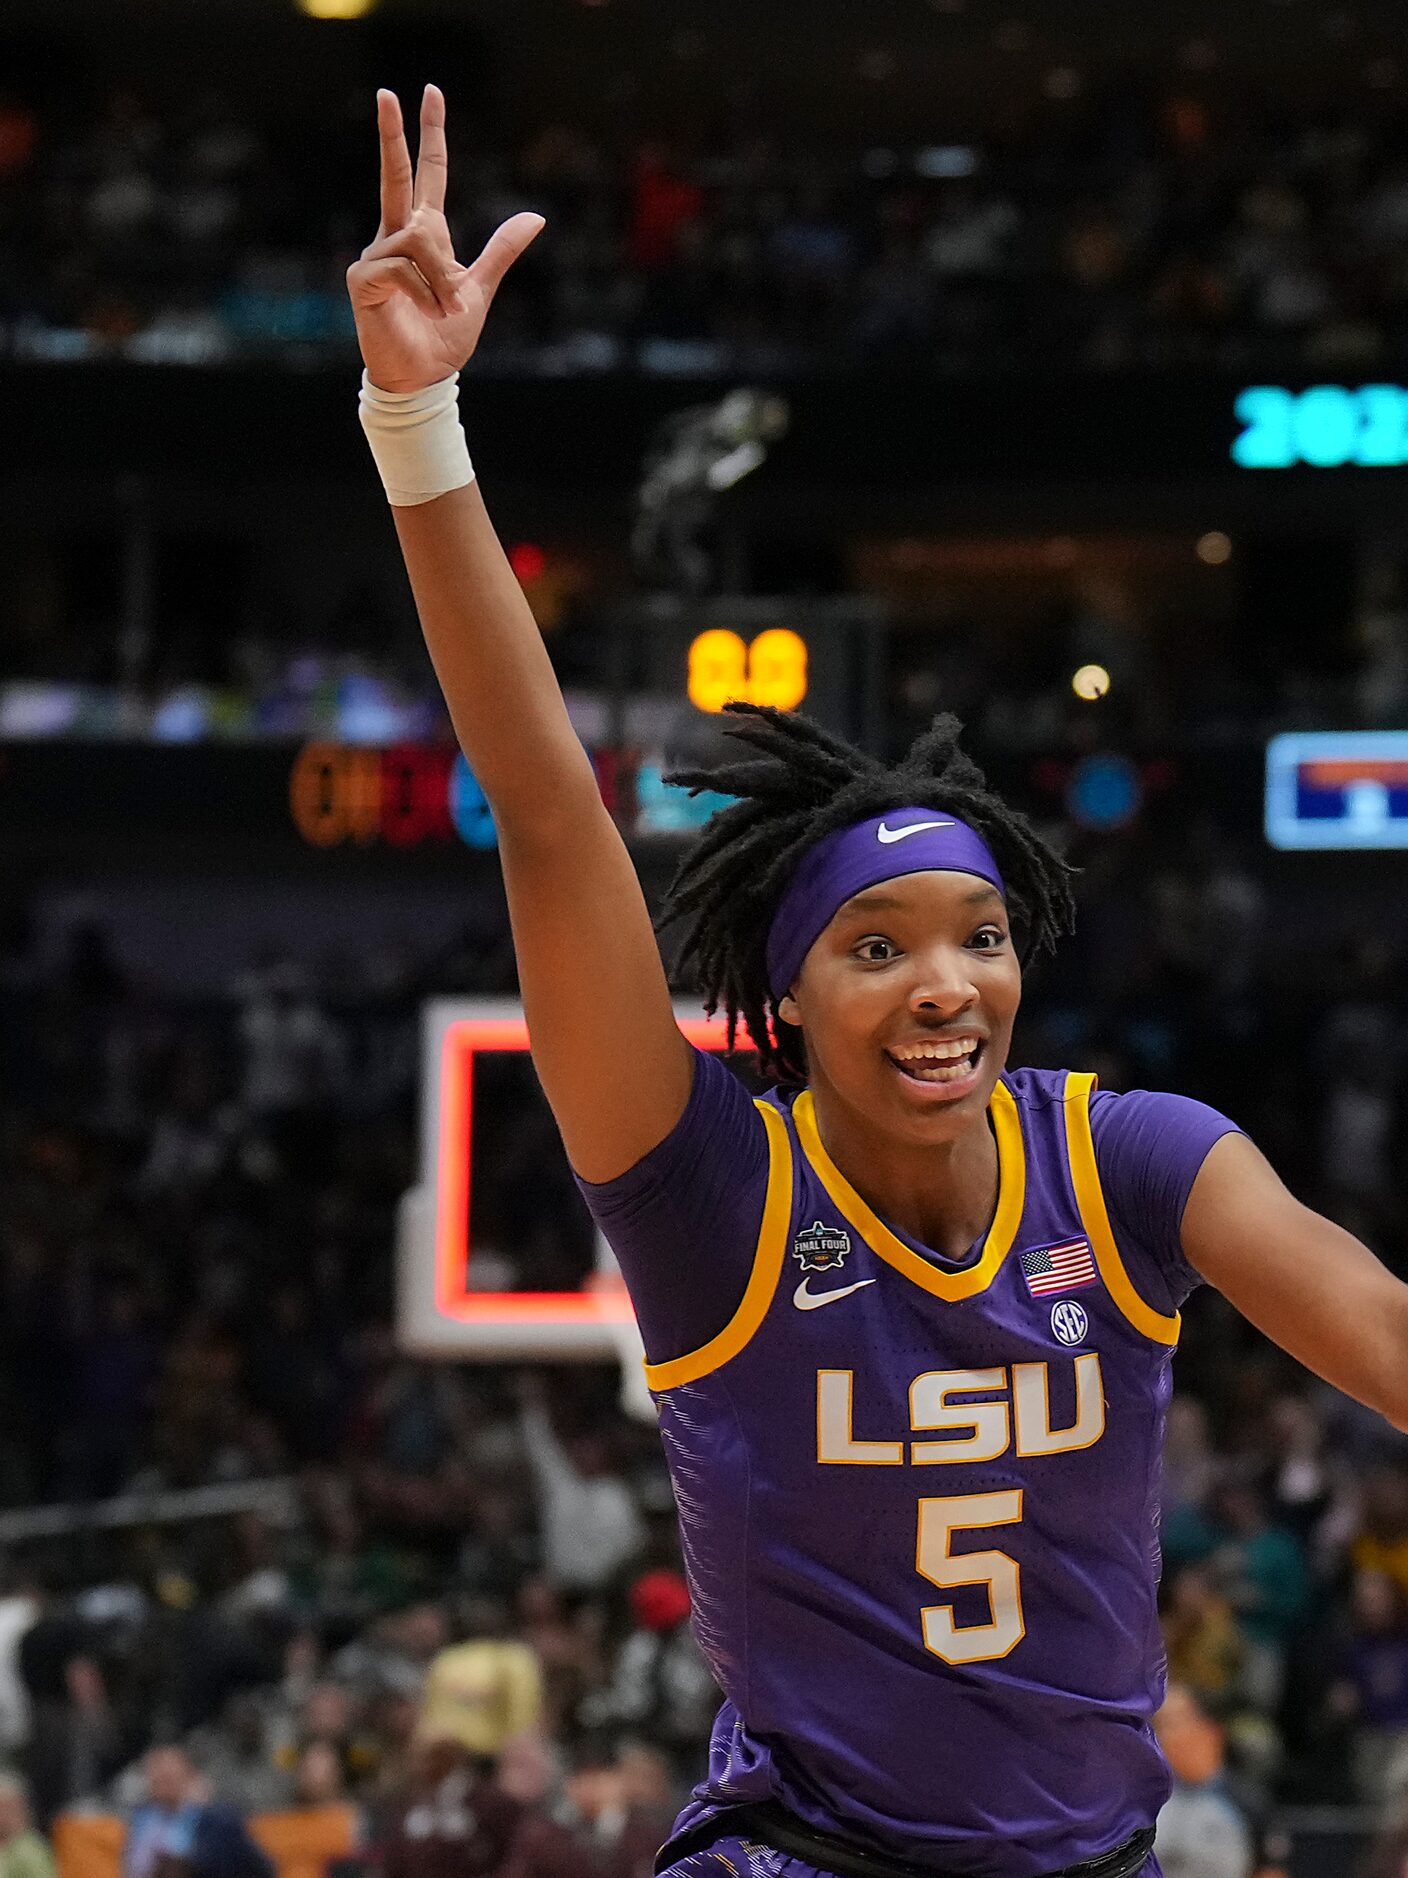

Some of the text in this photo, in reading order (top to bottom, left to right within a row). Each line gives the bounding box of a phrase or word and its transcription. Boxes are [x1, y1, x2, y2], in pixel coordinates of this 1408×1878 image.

[795, 1240, 846, 1253] FINAL FOUR
[1055, 1303, 1085, 1342] SEC
[816, 1353, 1106, 1466] LSU
[915, 1489, 1026, 1665] 5
